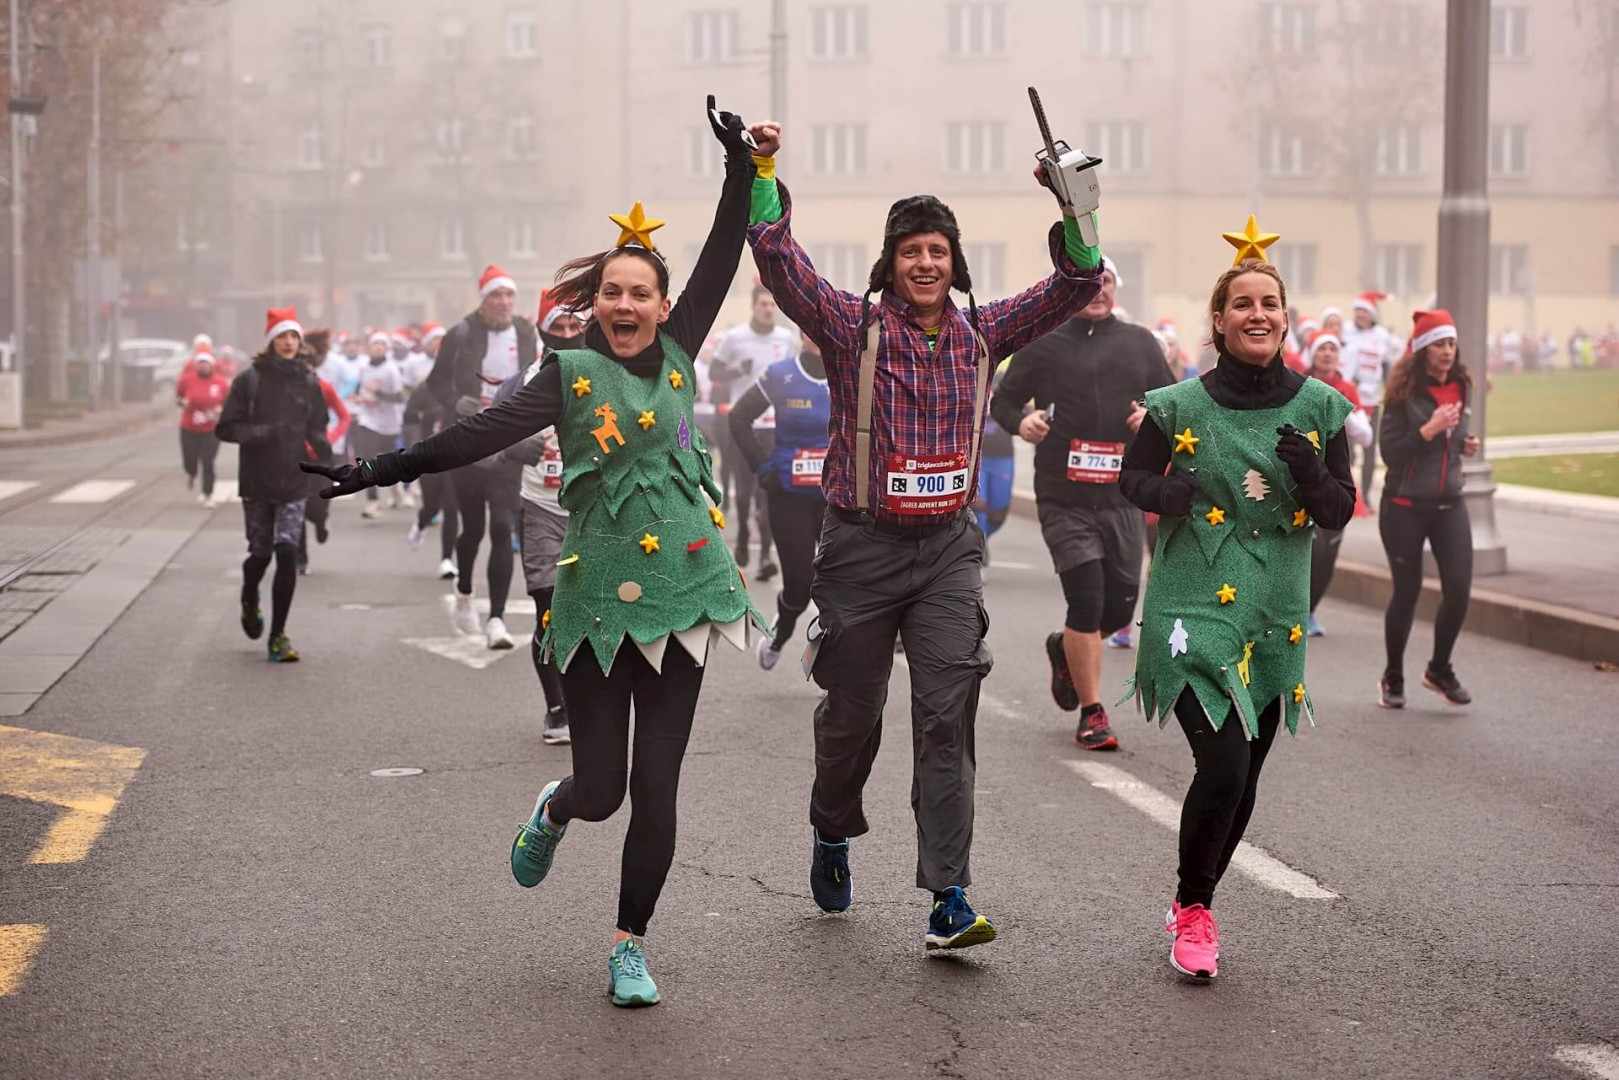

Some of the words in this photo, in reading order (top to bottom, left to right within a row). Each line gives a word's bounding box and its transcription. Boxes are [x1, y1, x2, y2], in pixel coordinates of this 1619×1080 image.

[1088, 456, 1106, 467] 774
[917, 475, 945, 493] 900
[919, 501, 938, 509] ADVENT
[938, 500, 948, 508] RUN
